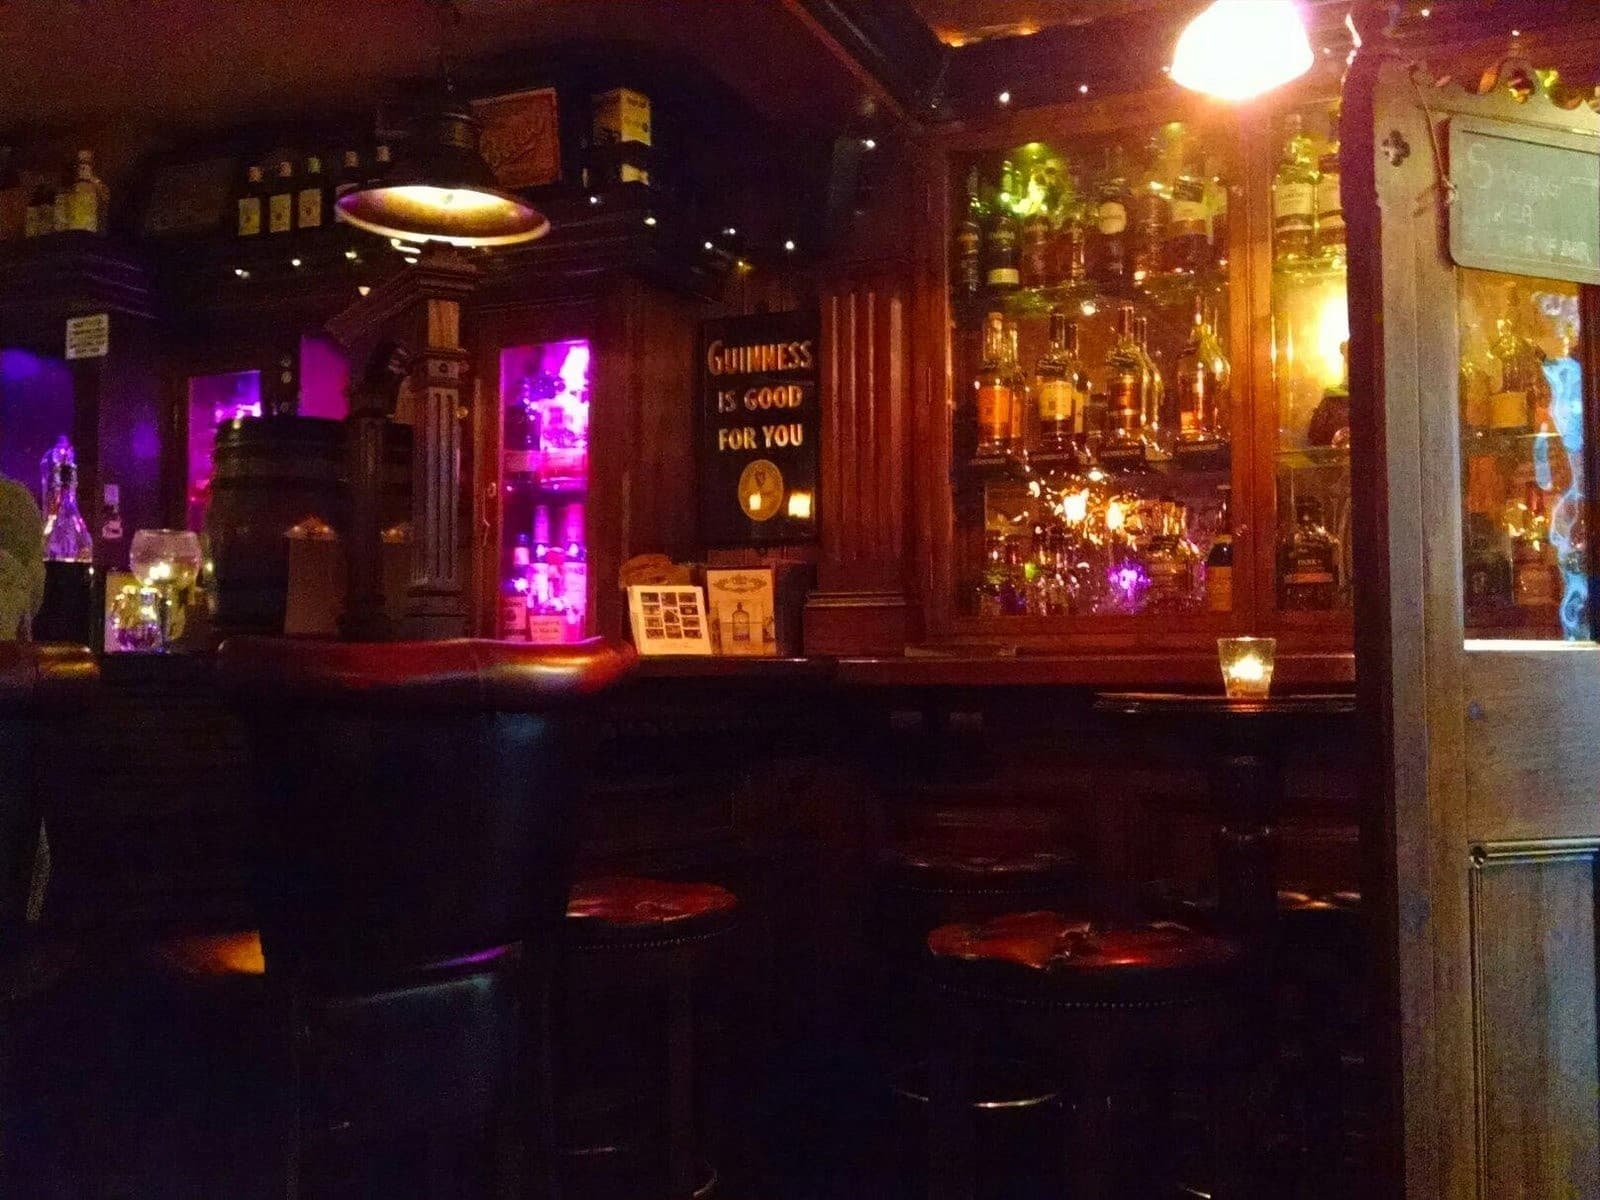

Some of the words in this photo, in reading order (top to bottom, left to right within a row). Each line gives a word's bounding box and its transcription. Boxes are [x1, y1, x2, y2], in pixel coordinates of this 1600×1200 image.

[707, 340, 813, 375] GUINNESS
[718, 390, 737, 413] IS
[744, 385, 803, 411] GOOD
[718, 426, 757, 451] FOR
[762, 423, 804, 448] YOU
